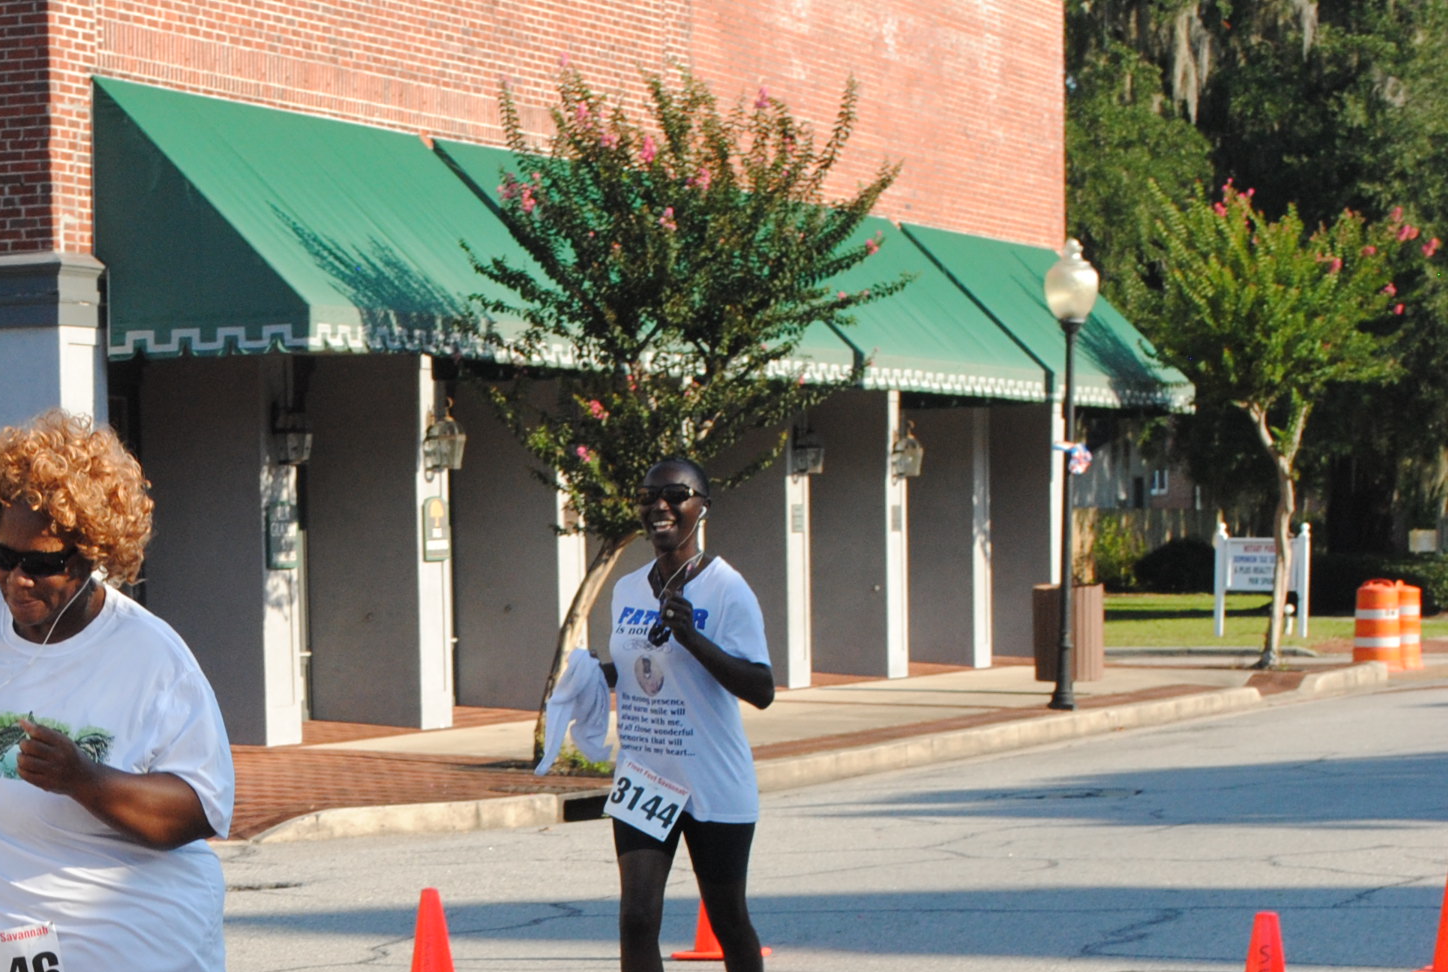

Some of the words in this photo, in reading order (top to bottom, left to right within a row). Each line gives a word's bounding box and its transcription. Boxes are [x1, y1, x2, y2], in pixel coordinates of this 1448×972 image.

[616, 624, 625, 635] is
[628, 625, 648, 635] not
[610, 776, 680, 830] 3144
[0, 925, 49, 943] Savannah
